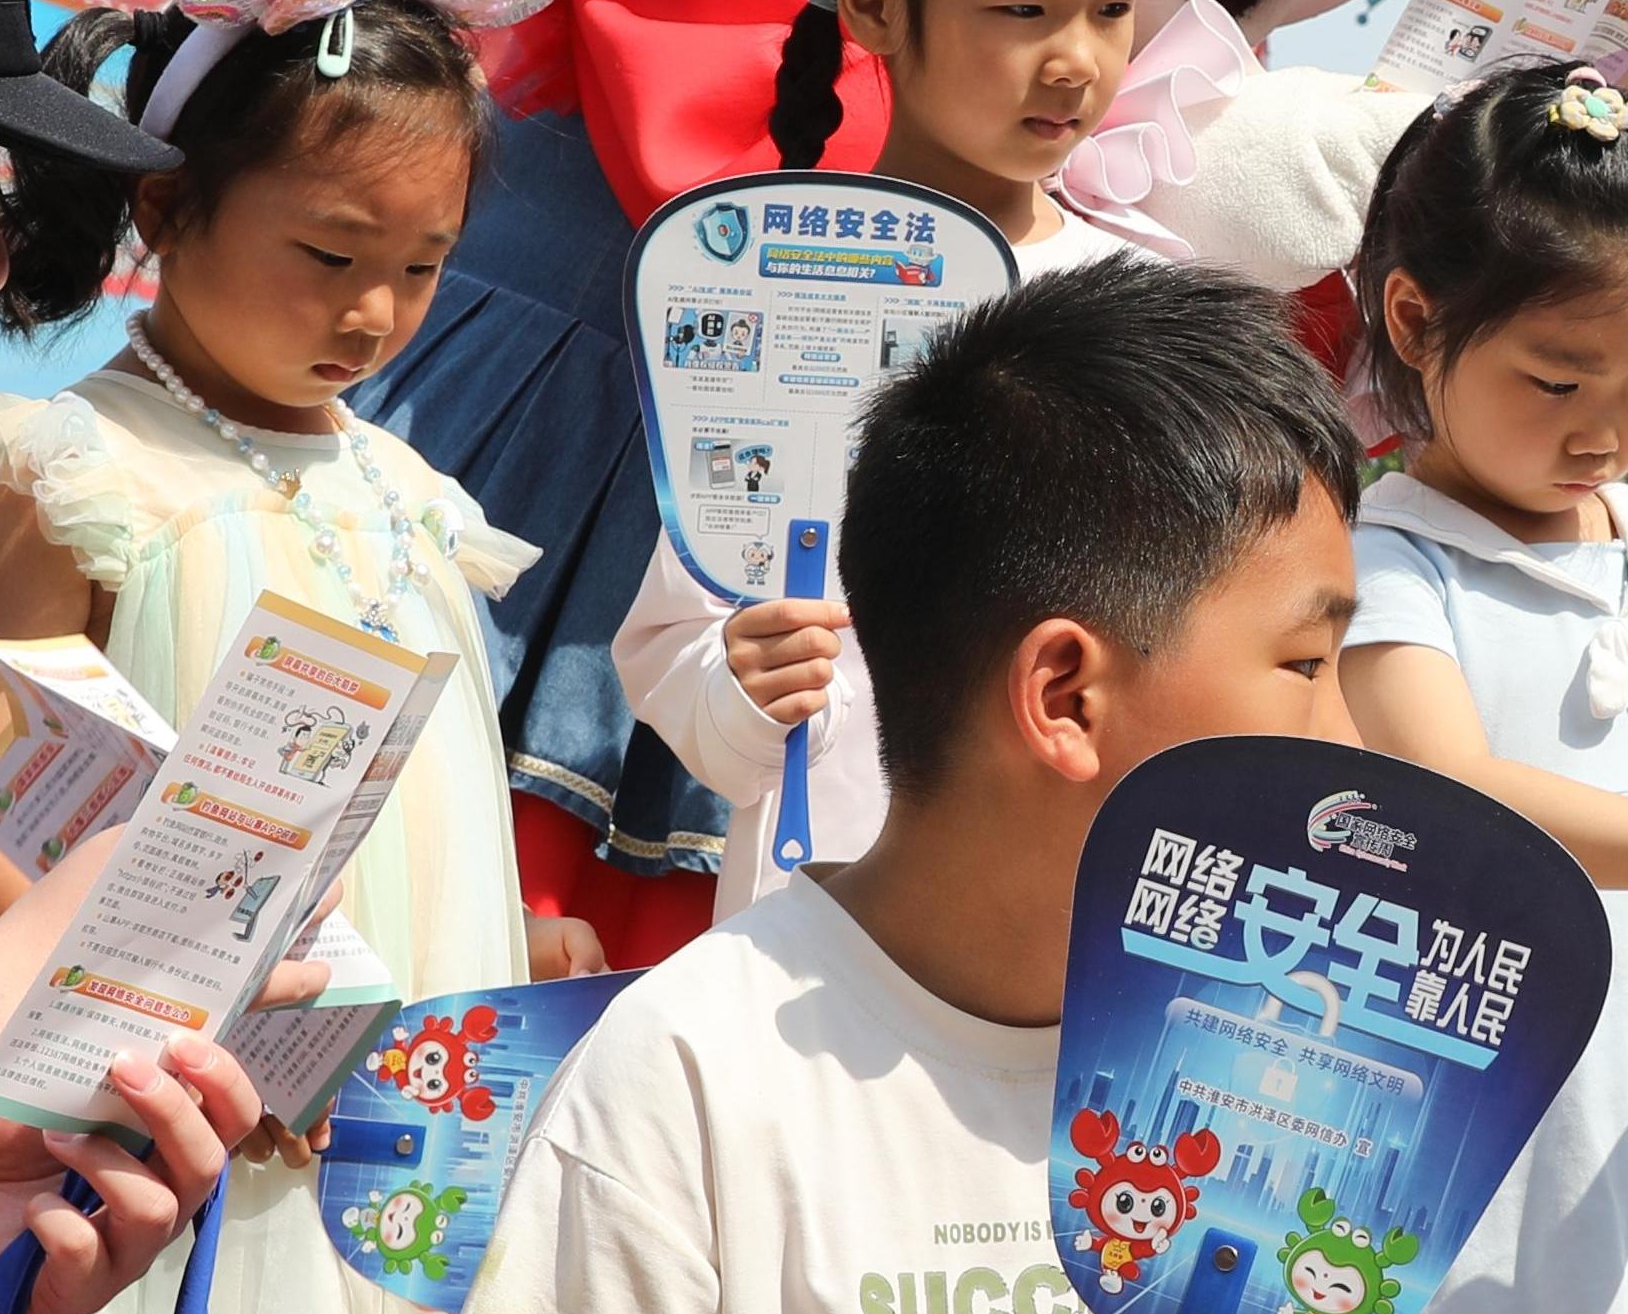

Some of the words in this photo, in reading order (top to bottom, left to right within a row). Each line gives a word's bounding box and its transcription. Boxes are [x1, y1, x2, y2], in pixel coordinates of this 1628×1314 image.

[763, 203, 936, 244] 网络安全法
[1142, 829, 1241, 900] 网络
[1233, 866, 1422, 1017] 安全
[1420, 919, 1531, 996] 为人民
[1404, 969, 1515, 1048] 靠人民
[1184, 1007, 1289, 1059] 共建网络安全
[1298, 1045, 1406, 1097] 共享网络文明
[1177, 1077, 1349, 1150] 中共淮安市洪泽区委网信办
[1354, 1137, 1373, 1159] 宣
[934, 1222, 1020, 1245] NOBODY
[1025, 1221, 1042, 1241] IS
